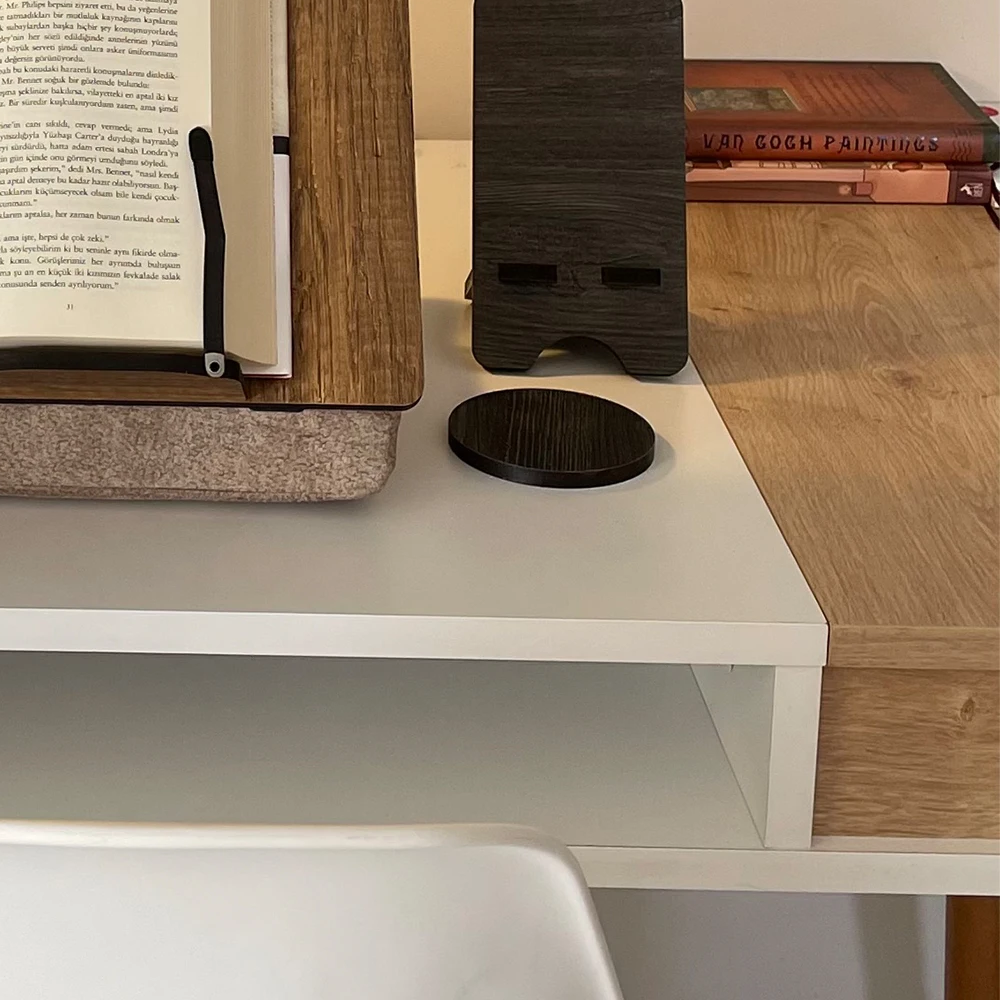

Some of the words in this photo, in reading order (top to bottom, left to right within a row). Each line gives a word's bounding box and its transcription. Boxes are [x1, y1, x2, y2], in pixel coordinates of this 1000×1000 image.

[703, 133, 744, 152] VAN
[755, 134, 813, 151] GOGH
[824, 134, 940, 154] PAINTINGS
